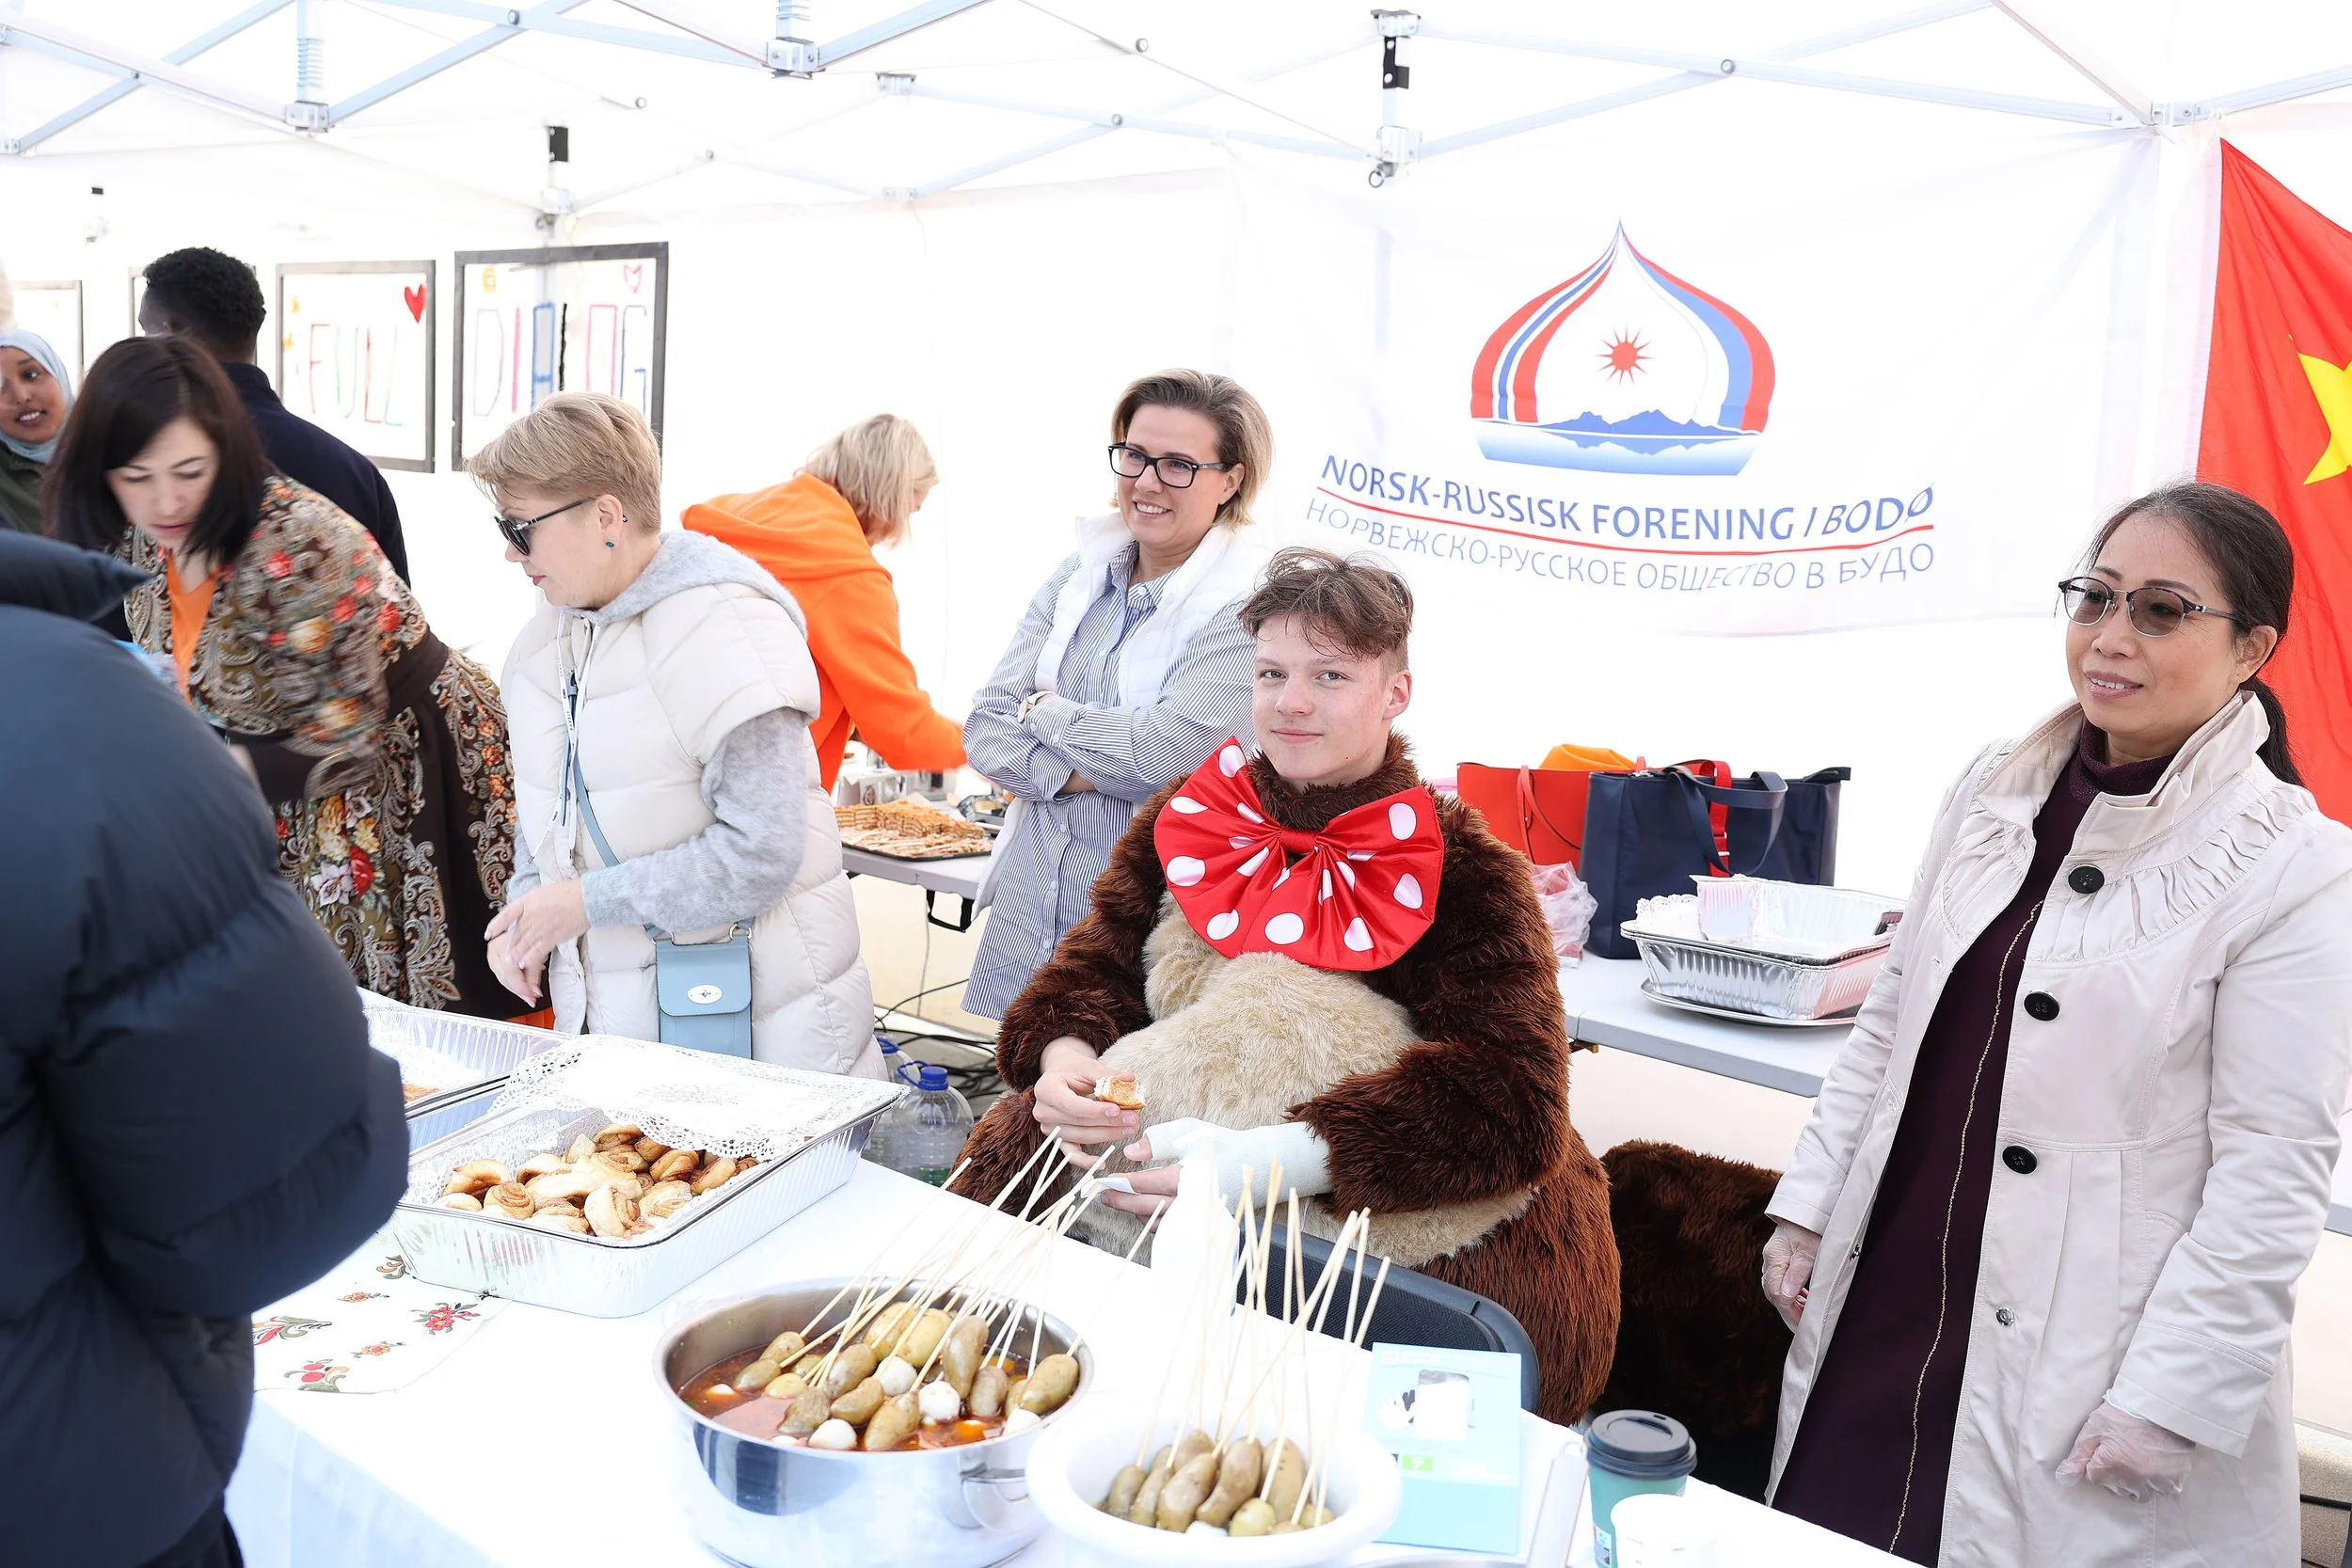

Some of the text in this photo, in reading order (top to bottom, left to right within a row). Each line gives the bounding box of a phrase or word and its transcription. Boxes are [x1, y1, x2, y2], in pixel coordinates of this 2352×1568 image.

[309, 323, 403, 427] FULL
[1321, 455, 1581, 532] NORSK-RUSSISK
[1593, 504, 1794, 540] FORENING
[1820, 482, 1934, 535] BODØ
[1307, 498, 1934, 594] НОРВЕЖСКО-РУССКОЕ ОБЩЕСТВО В БУДО
